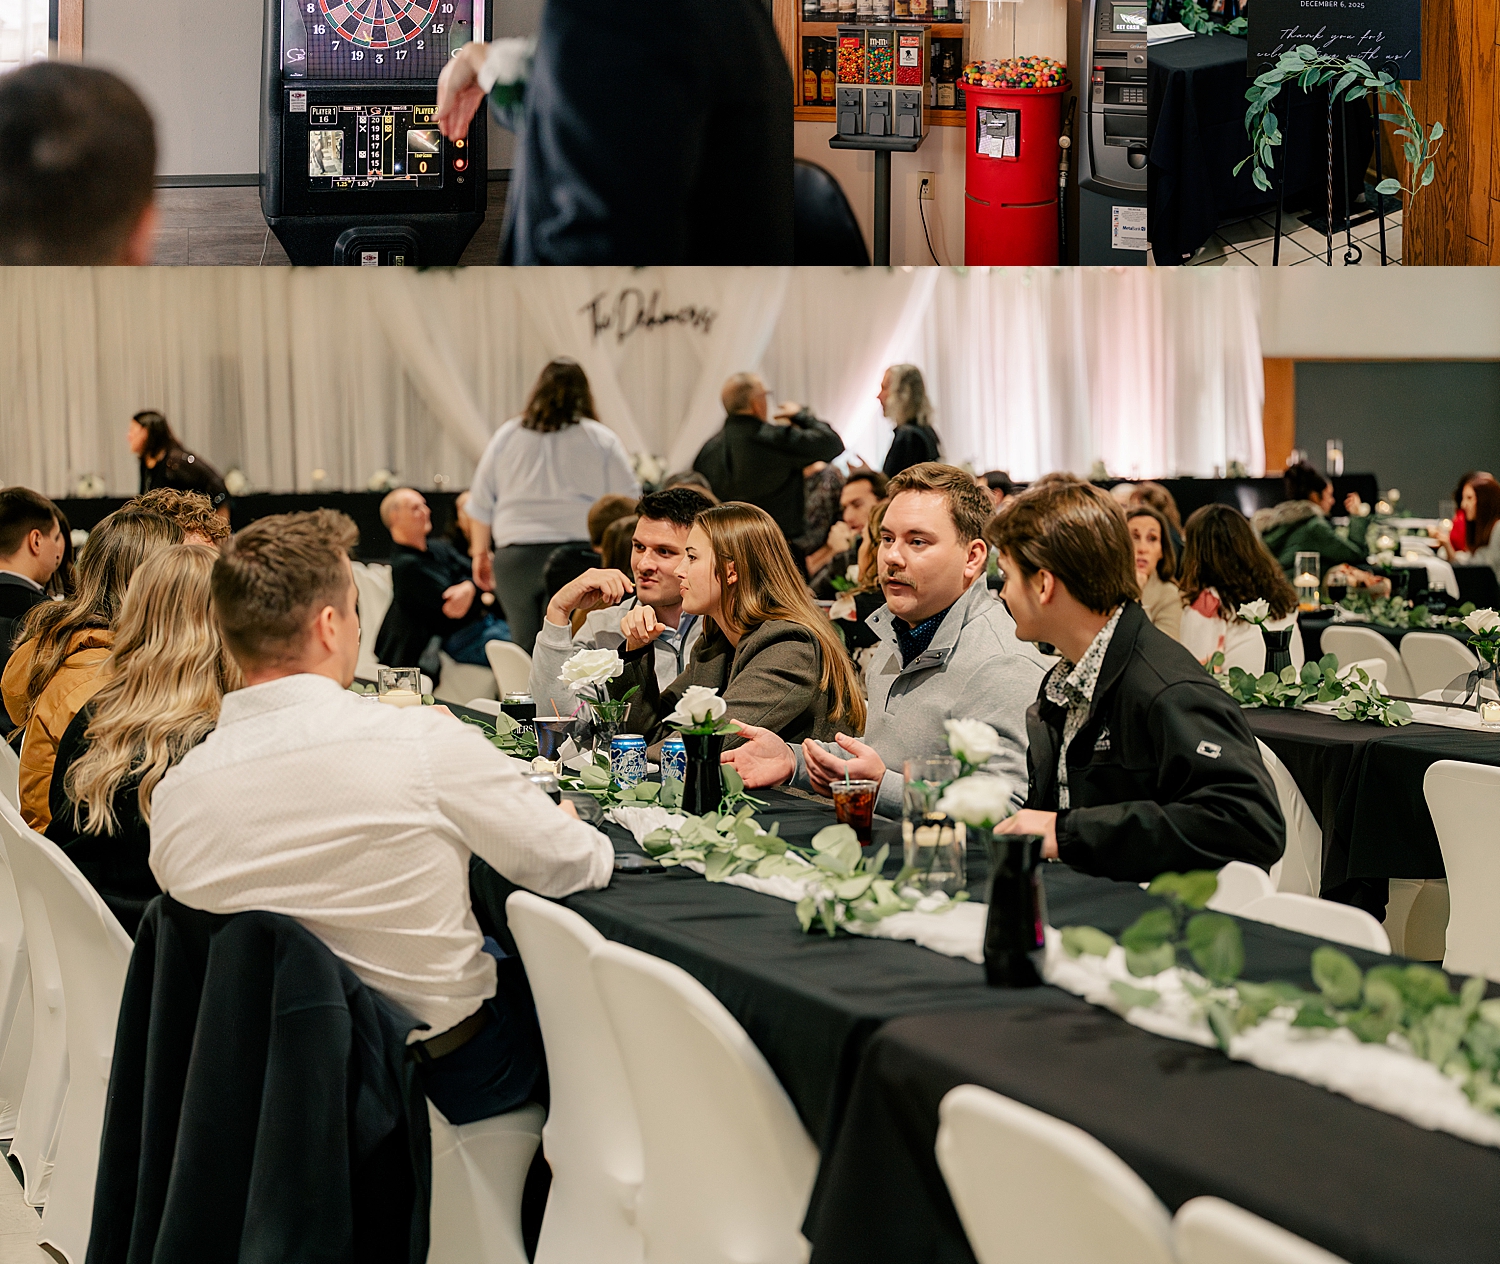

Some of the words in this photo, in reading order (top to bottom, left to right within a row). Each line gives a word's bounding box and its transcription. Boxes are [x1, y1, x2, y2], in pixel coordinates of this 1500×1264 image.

[307, 3, 315, 13] 8
[442, 4, 453, 13] 10
[1300, 0, 1338, 8] DECEMBER
[1340, 0, 1347, 9] 6,
[313, 25, 325, 35] 16
[432, 24, 444, 34] 15
[1280, 25, 1327, 41] Thank
[1323, 34, 1355, 48] you
[1357, 29, 1386, 46] for
[332, 41, 341, 50] 7
[417, 40, 425, 50] 2
[351, 50, 364, 60] 19
[395, 50, 408, 60] 17
[1345, 45, 1381, 60] with
[375, 54, 384, 64] 3
[312, 107, 331, 115] PLAYER
[332, 107, 336, 115] 1
[415, 107, 433, 115] PLAYER
[419, 161, 428, 173] 0
